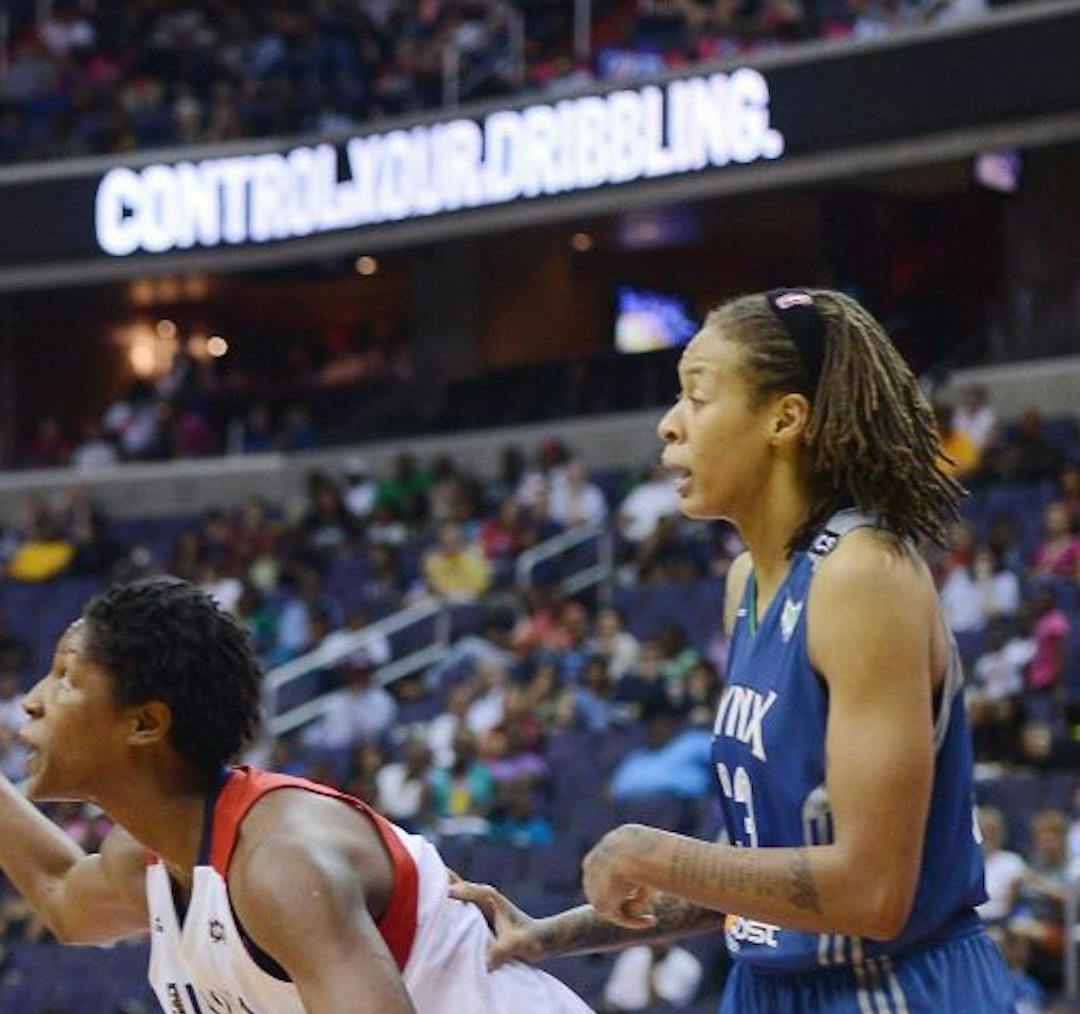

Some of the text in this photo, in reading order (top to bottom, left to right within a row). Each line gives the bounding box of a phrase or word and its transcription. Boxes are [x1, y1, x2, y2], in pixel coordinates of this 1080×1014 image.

[96, 67, 785, 256] CONTROL YOUR DRIBBLING.
